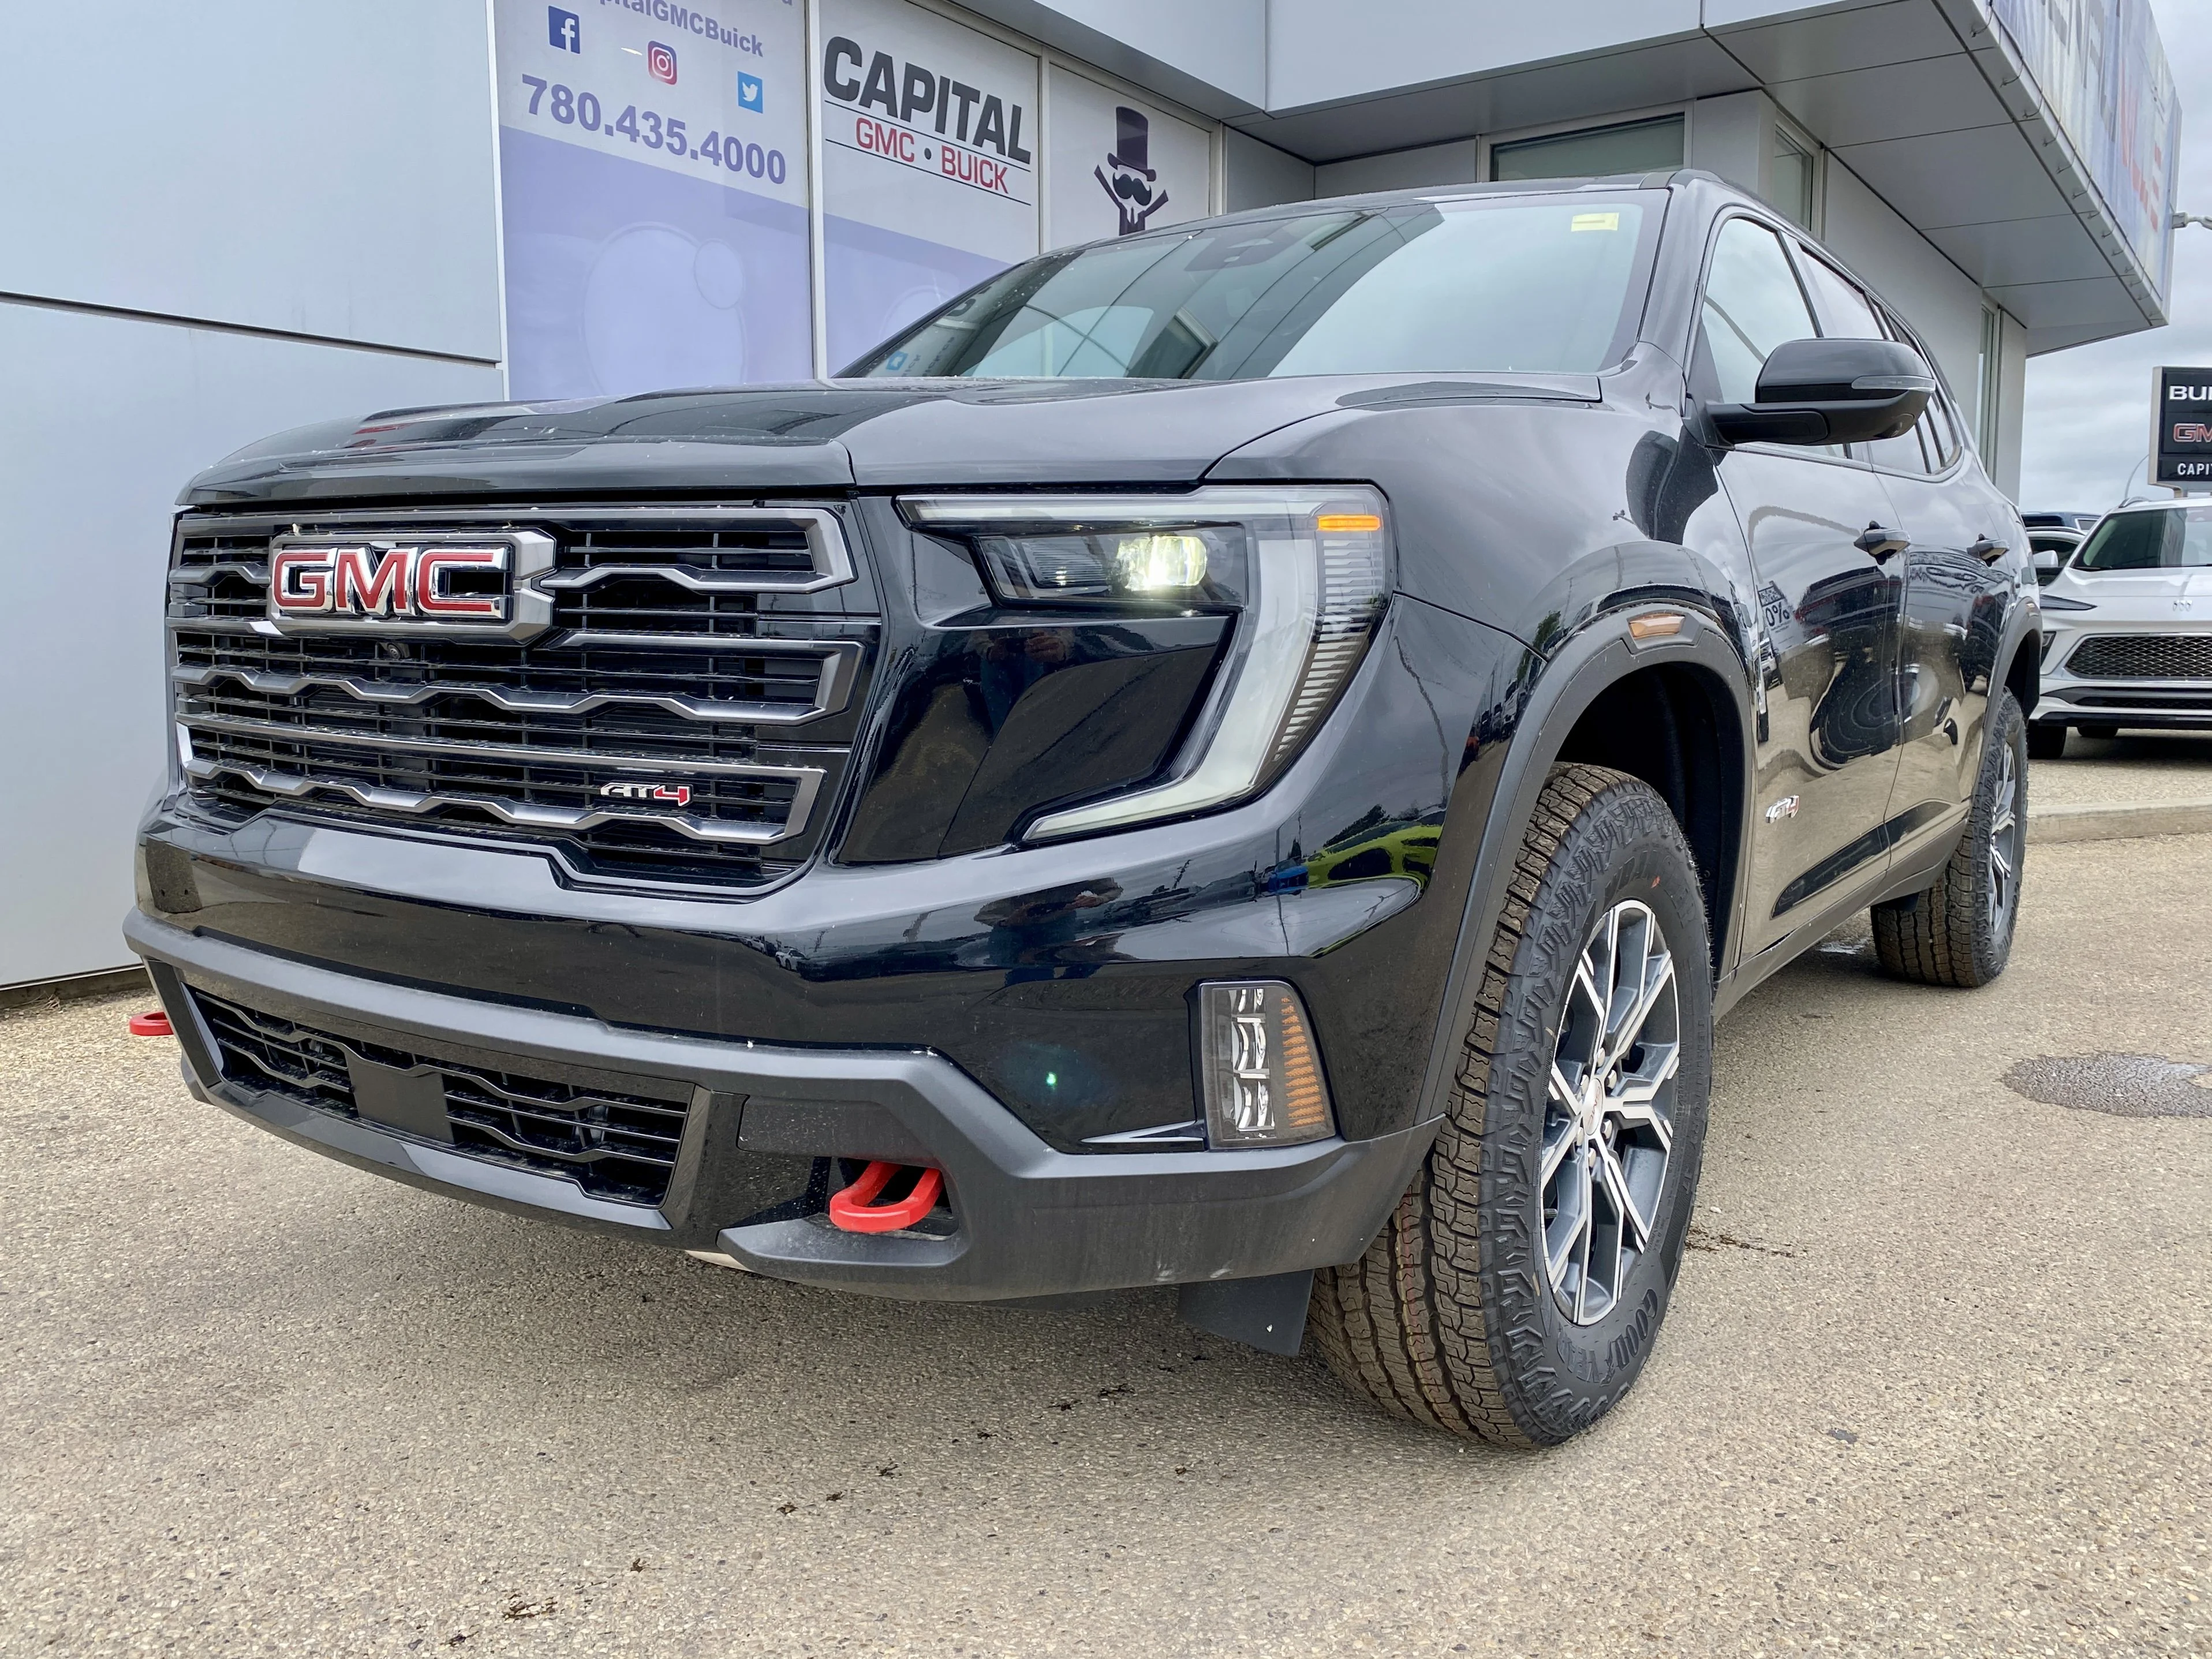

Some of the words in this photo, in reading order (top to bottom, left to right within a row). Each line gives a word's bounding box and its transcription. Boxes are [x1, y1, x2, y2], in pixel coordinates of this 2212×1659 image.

[522, 74, 786, 184] 780.435.4000
[824, 36, 1031, 165] CAPITAL
[855, 118, 914, 163] GMC
[941, 146, 1008, 194] BUICK
[2177, 463, 2212, 476] CAPI
[272, 547, 513, 619] GMC
[600, 782, 690, 806] AT4
